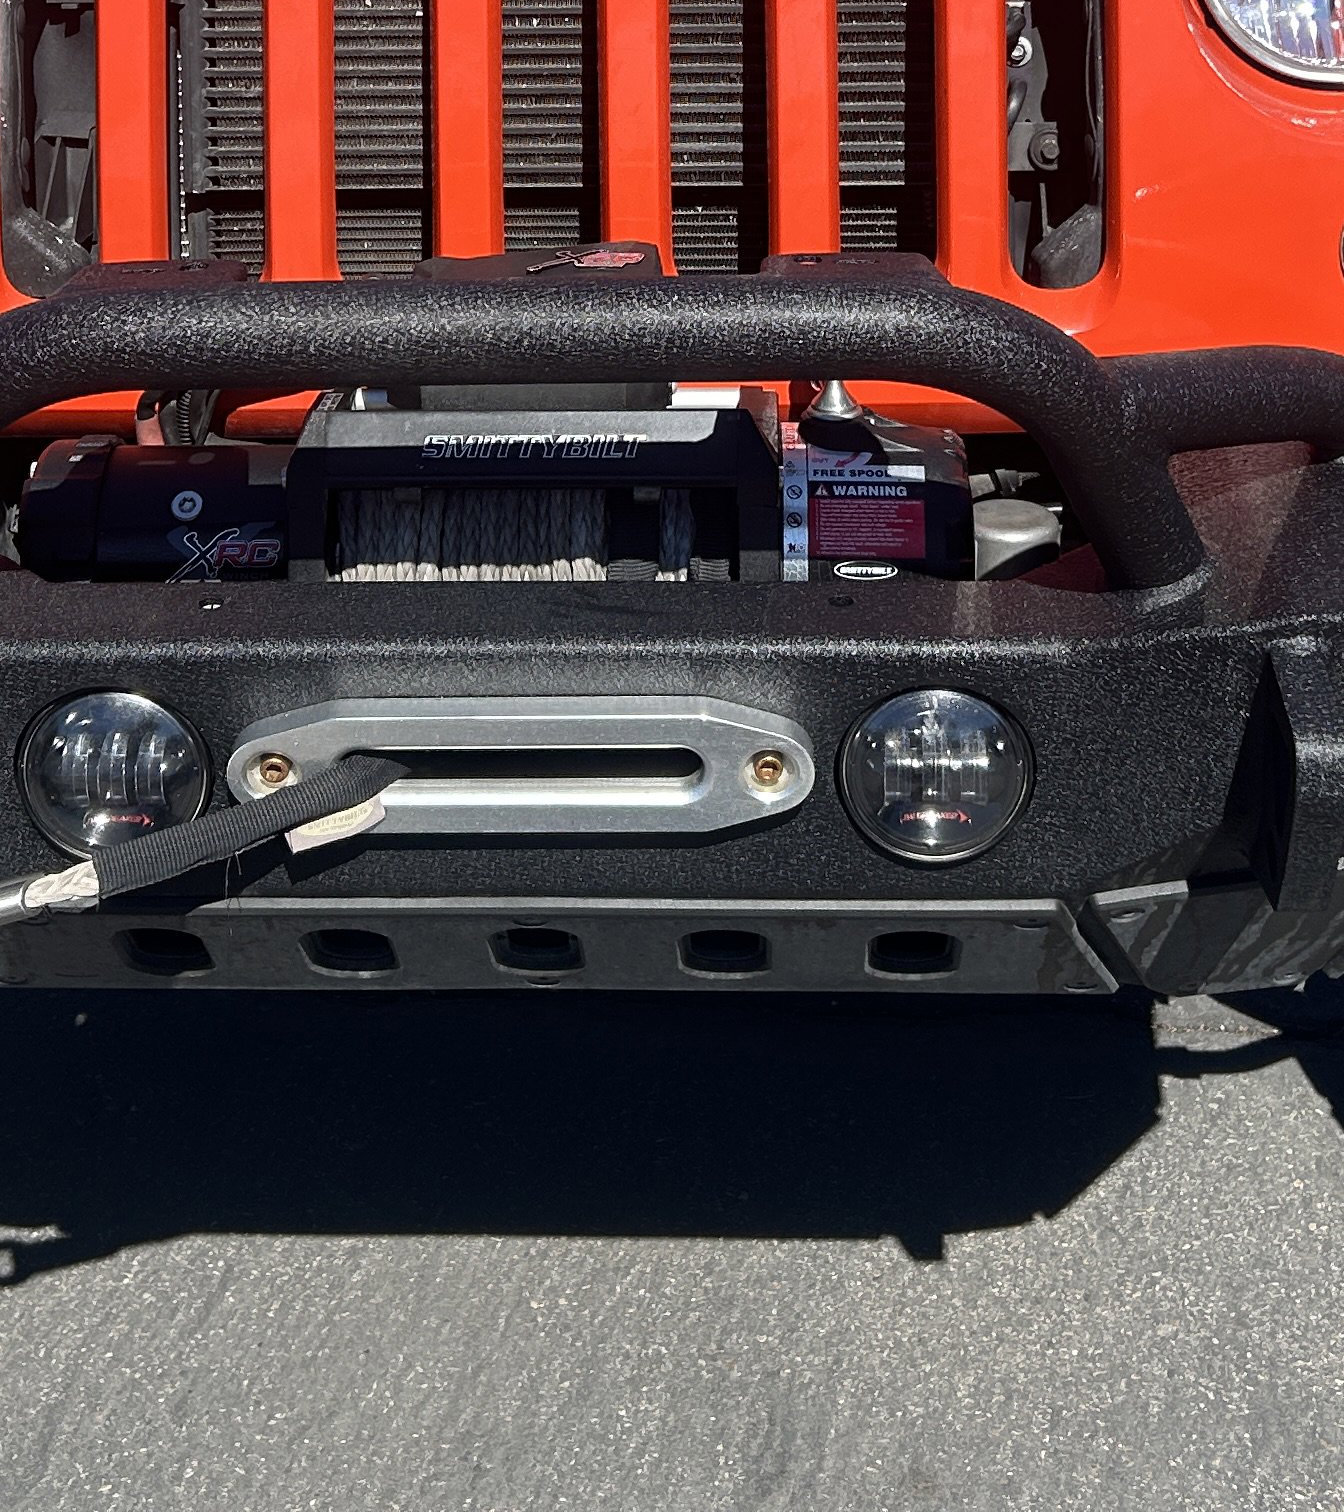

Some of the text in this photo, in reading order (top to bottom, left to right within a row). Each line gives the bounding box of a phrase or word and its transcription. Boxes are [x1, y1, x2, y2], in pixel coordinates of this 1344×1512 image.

[422, 433, 647, 459] SMITTYBILT
[812, 469, 846, 477] FREE
[833, 485, 907, 497] WARNING
